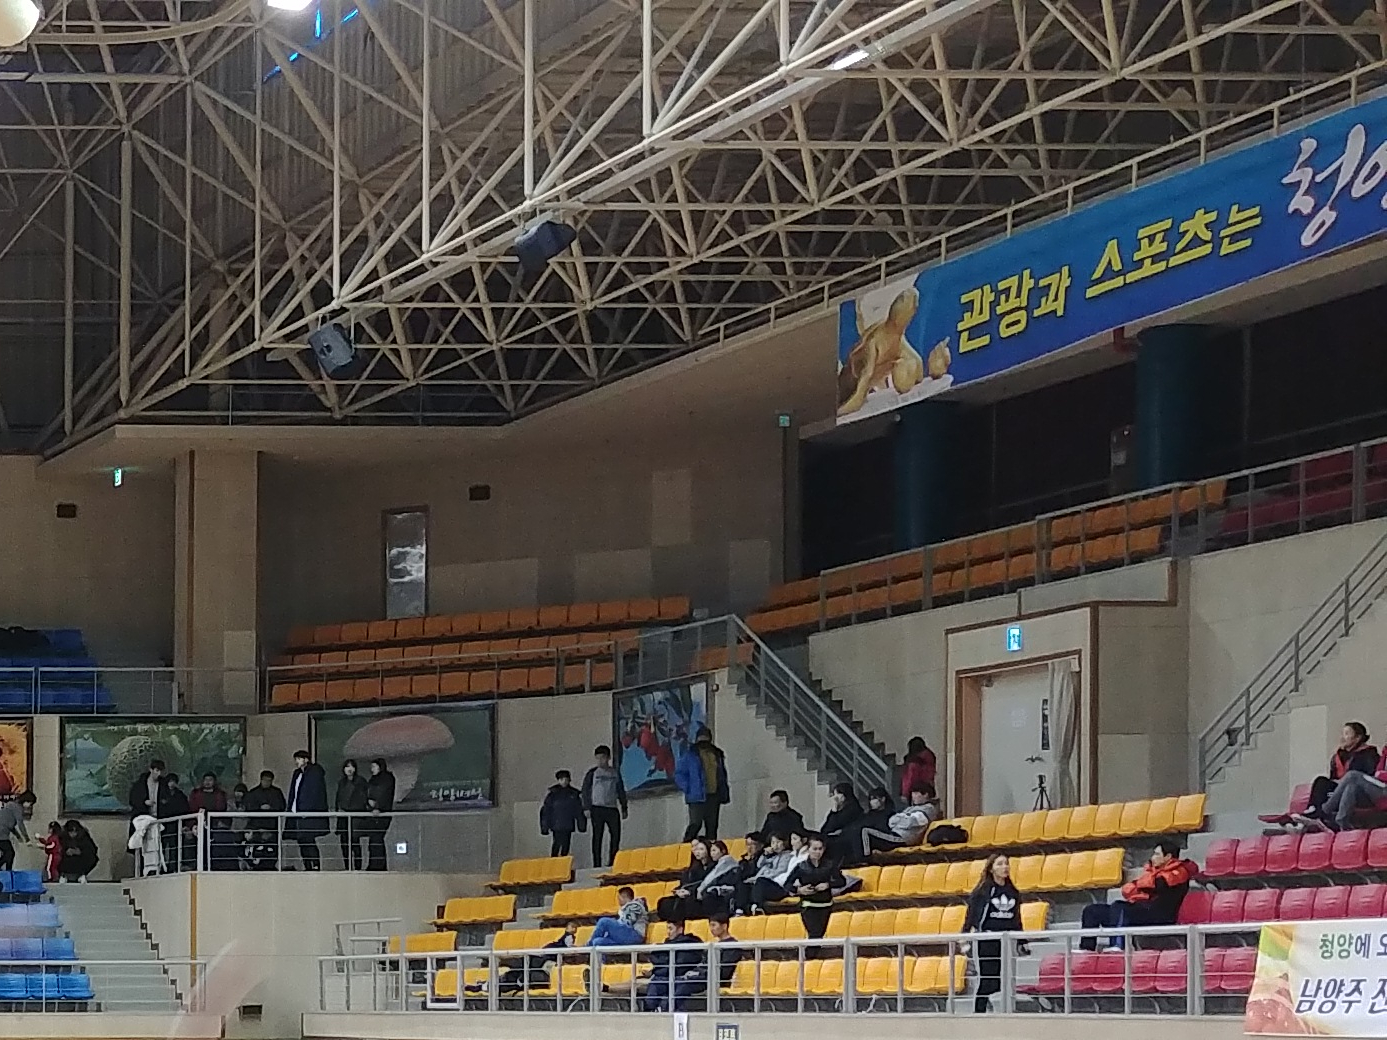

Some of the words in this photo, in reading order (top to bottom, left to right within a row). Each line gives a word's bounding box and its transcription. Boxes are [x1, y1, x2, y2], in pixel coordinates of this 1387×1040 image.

[956, 265, 1071, 354] 관광과
[1085, 203, 1262, 299] 스포츠는
[1319, 933, 1372, 960] 청양에
[1295, 977, 1367, 1015] 남양주
